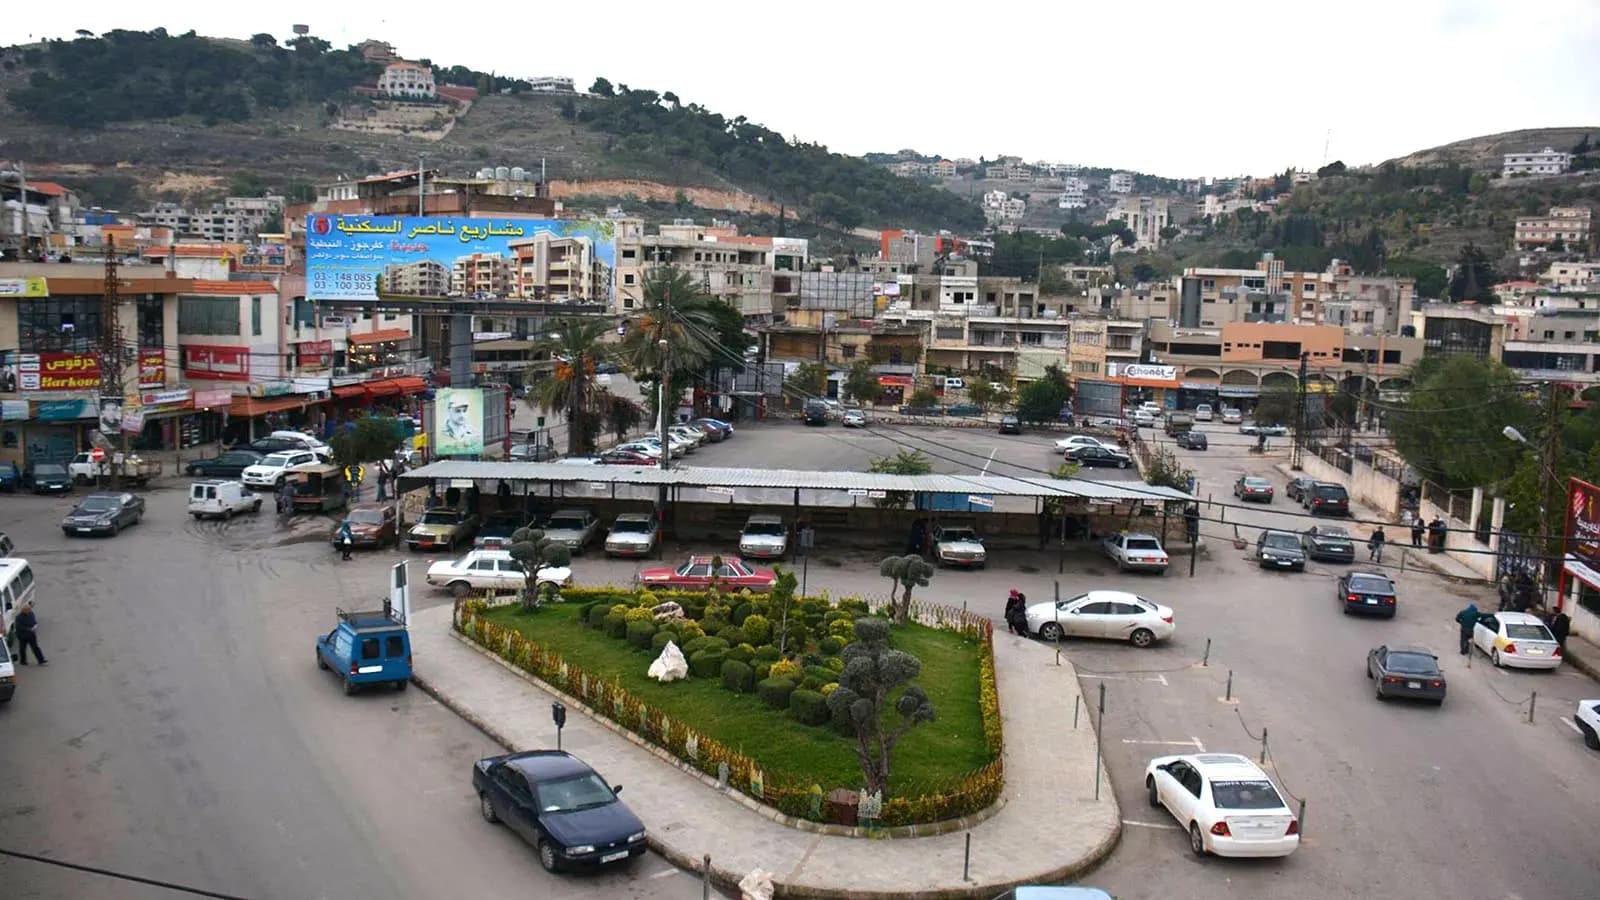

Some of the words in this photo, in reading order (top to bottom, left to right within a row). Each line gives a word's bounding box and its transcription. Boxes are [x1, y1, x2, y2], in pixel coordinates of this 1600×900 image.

[336, 217, 402, 236] السكنية
[408, 220, 455, 239] ناصر
[459, 219, 524, 243] مشاريع
[314, 272, 326, 281] 03
[335, 272, 352, 281] 148
[314, 281, 326, 289] 03
[335, 281, 352, 290] 100
[354, 282, 372, 290] 305
[41, 377, 100, 387] Harkous
